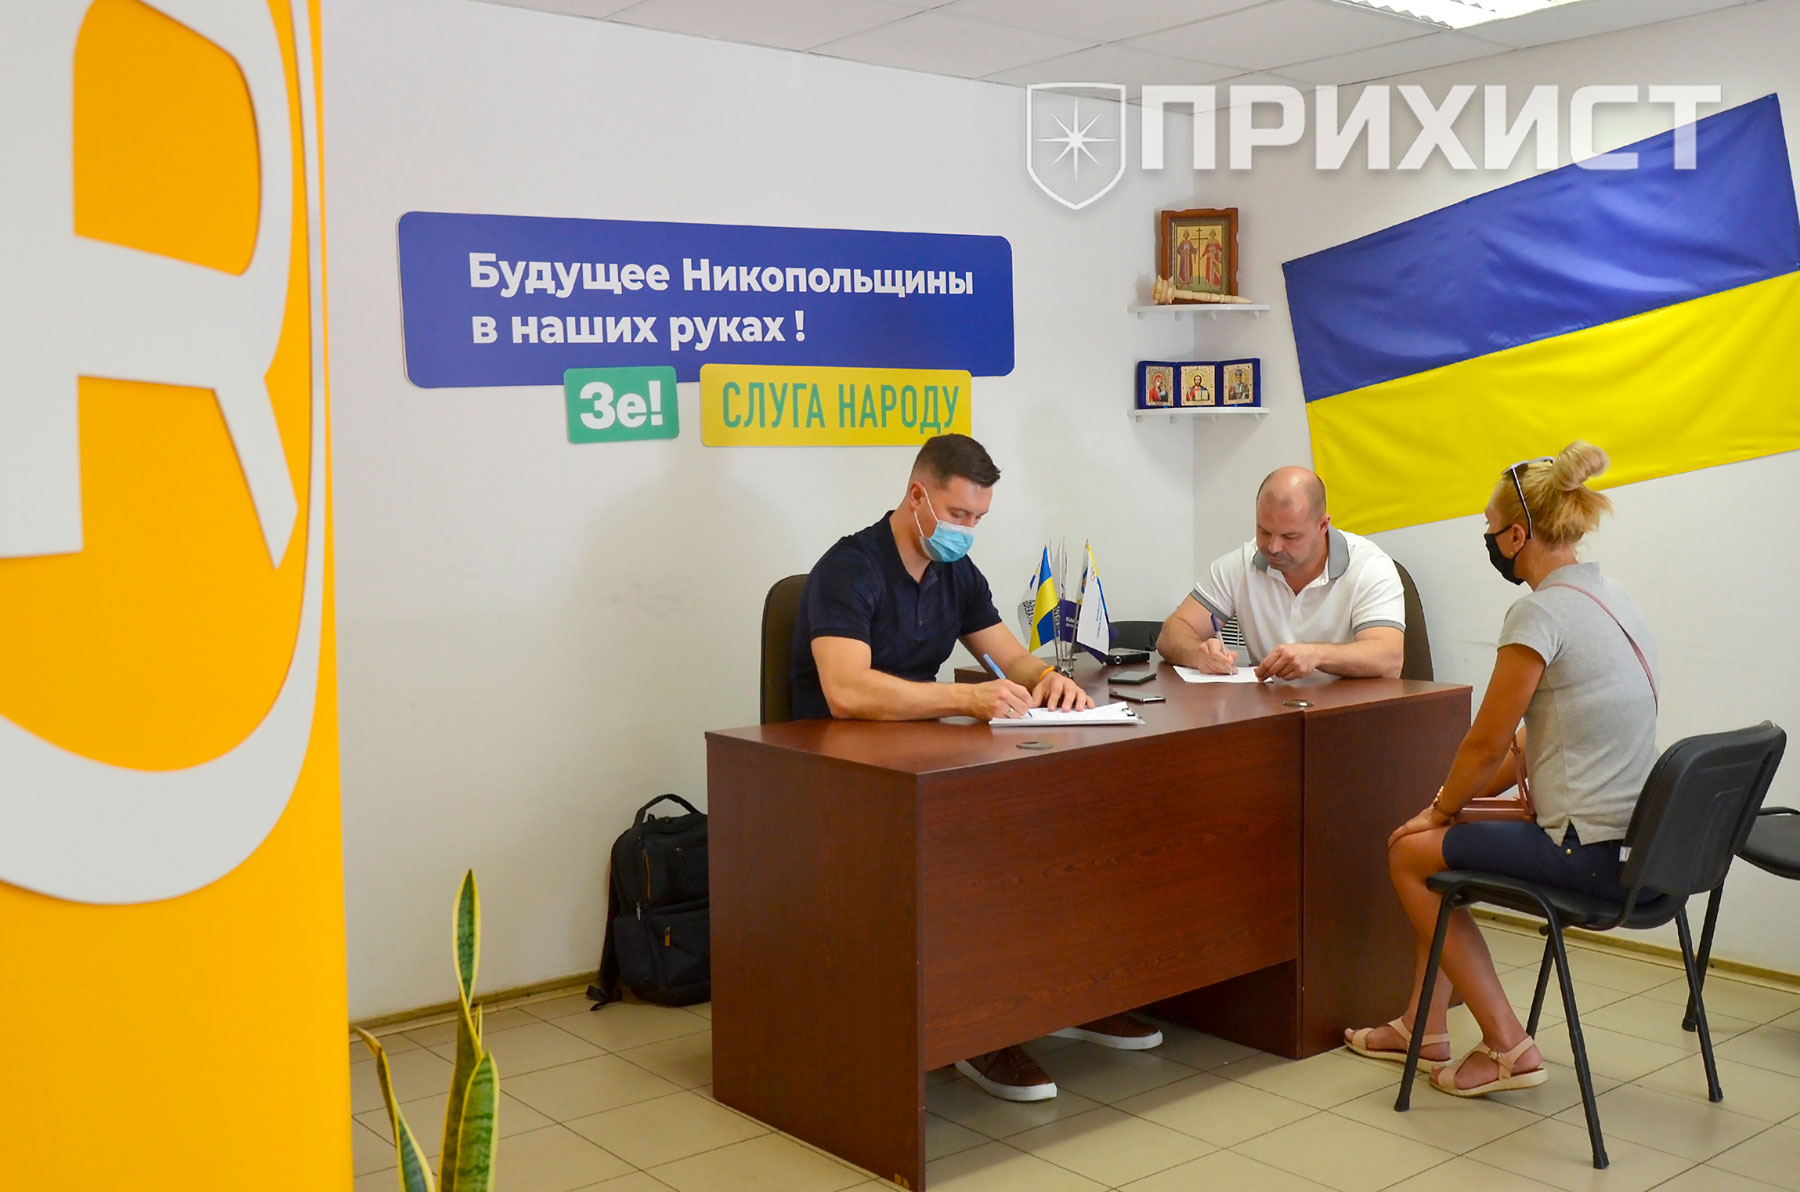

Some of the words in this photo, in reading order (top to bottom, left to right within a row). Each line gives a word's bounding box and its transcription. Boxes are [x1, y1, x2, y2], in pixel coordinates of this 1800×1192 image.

[468, 252, 671, 298] Будущее
[682, 257, 974, 298] Никопольщины
[471, 315, 498, 344] в
[511, 315, 659, 344] наших
[669, 316, 786, 352] руках
[579, 380, 664, 430] Зе!
[722, 381, 826, 429] СЛУГА
[838, 383, 960, 434] НАРОДУ
